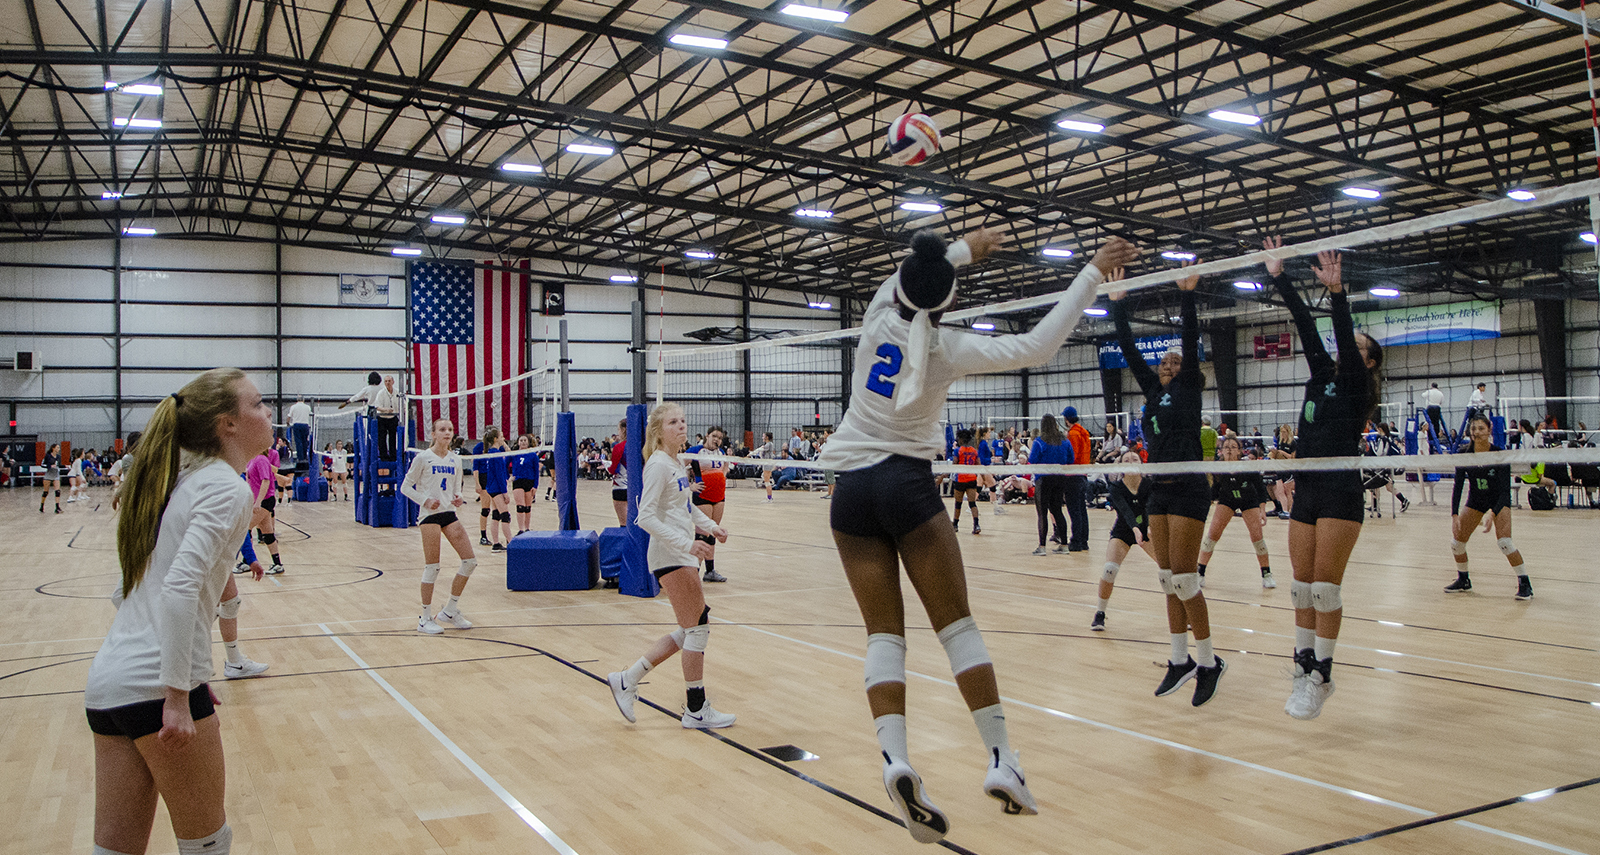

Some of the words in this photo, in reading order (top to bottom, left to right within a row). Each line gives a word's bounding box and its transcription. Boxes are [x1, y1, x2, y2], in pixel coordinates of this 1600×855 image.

[1384, 316, 1404, 324] We're
[1407, 313, 1428, 323] Glad
[1431, 311, 1455, 320] You're
[1459, 308, 1484, 317] Here!
[865, 342, 904, 400] 2
[1151, 415, 1161, 435] 1
[519, 457, 526, 465] 7
[432, 465, 455, 475] FUSION
[440, 477, 448, 491] 4
[1476, 478, 1489, 490] 12
[1232, 489, 1242, 499] 11
